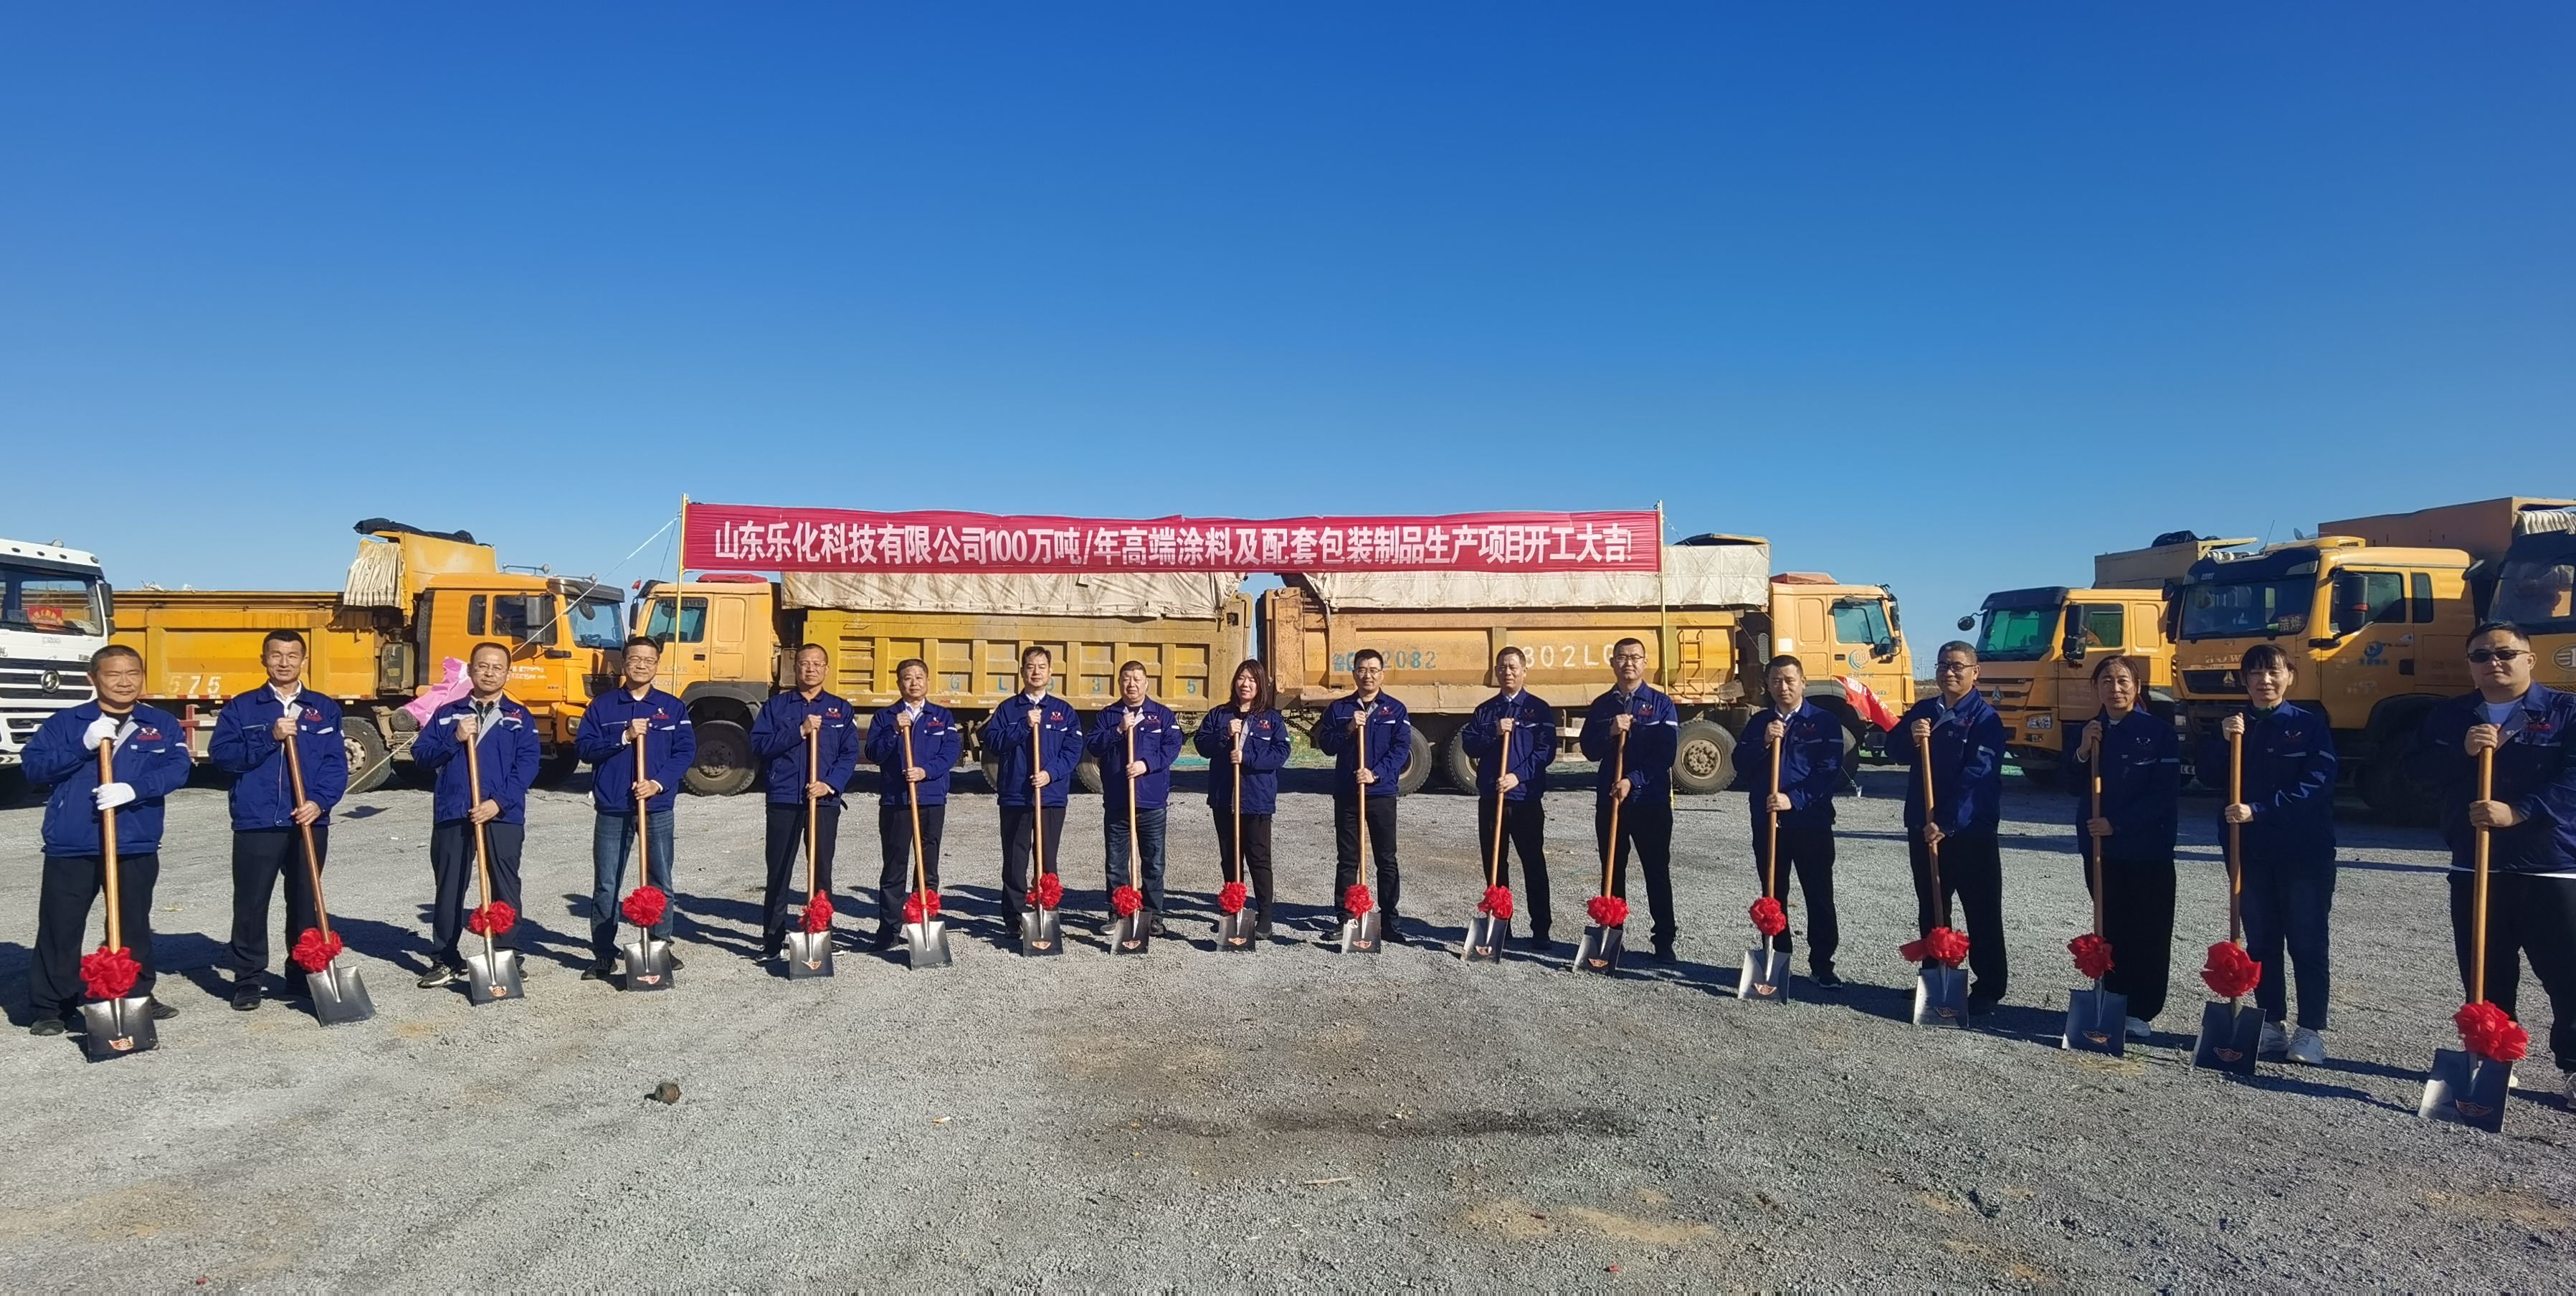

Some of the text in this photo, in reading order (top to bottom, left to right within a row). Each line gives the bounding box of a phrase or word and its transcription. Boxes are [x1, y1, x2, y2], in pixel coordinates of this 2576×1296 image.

[715, 520, 1632, 566] 山东乐化科技有限公司100万吨/年高端涂料及配套包装制品生产项目开工大吉!
[168, 675, 222, 695] 575
